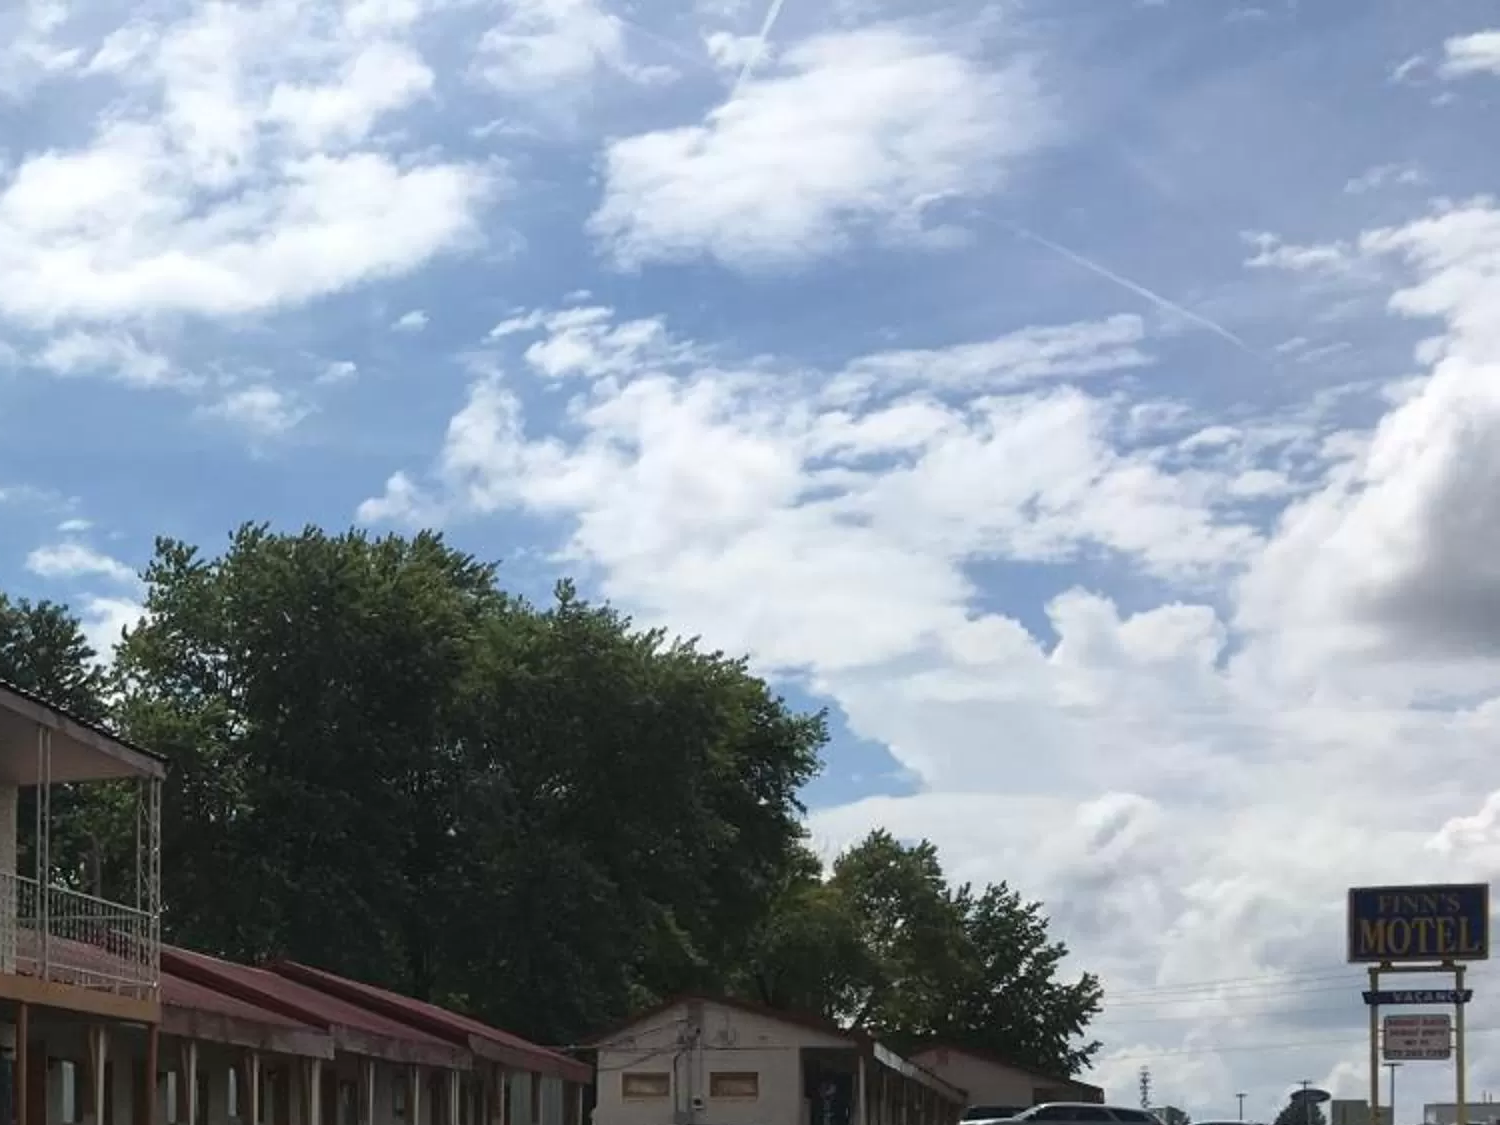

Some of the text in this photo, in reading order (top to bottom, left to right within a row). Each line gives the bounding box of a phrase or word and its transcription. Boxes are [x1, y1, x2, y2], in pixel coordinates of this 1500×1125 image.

[1379, 892, 1461, 913] FINN'S
[1359, 916, 1479, 954] MOTEL
[1393, 990, 1466, 1003] VACANCY
